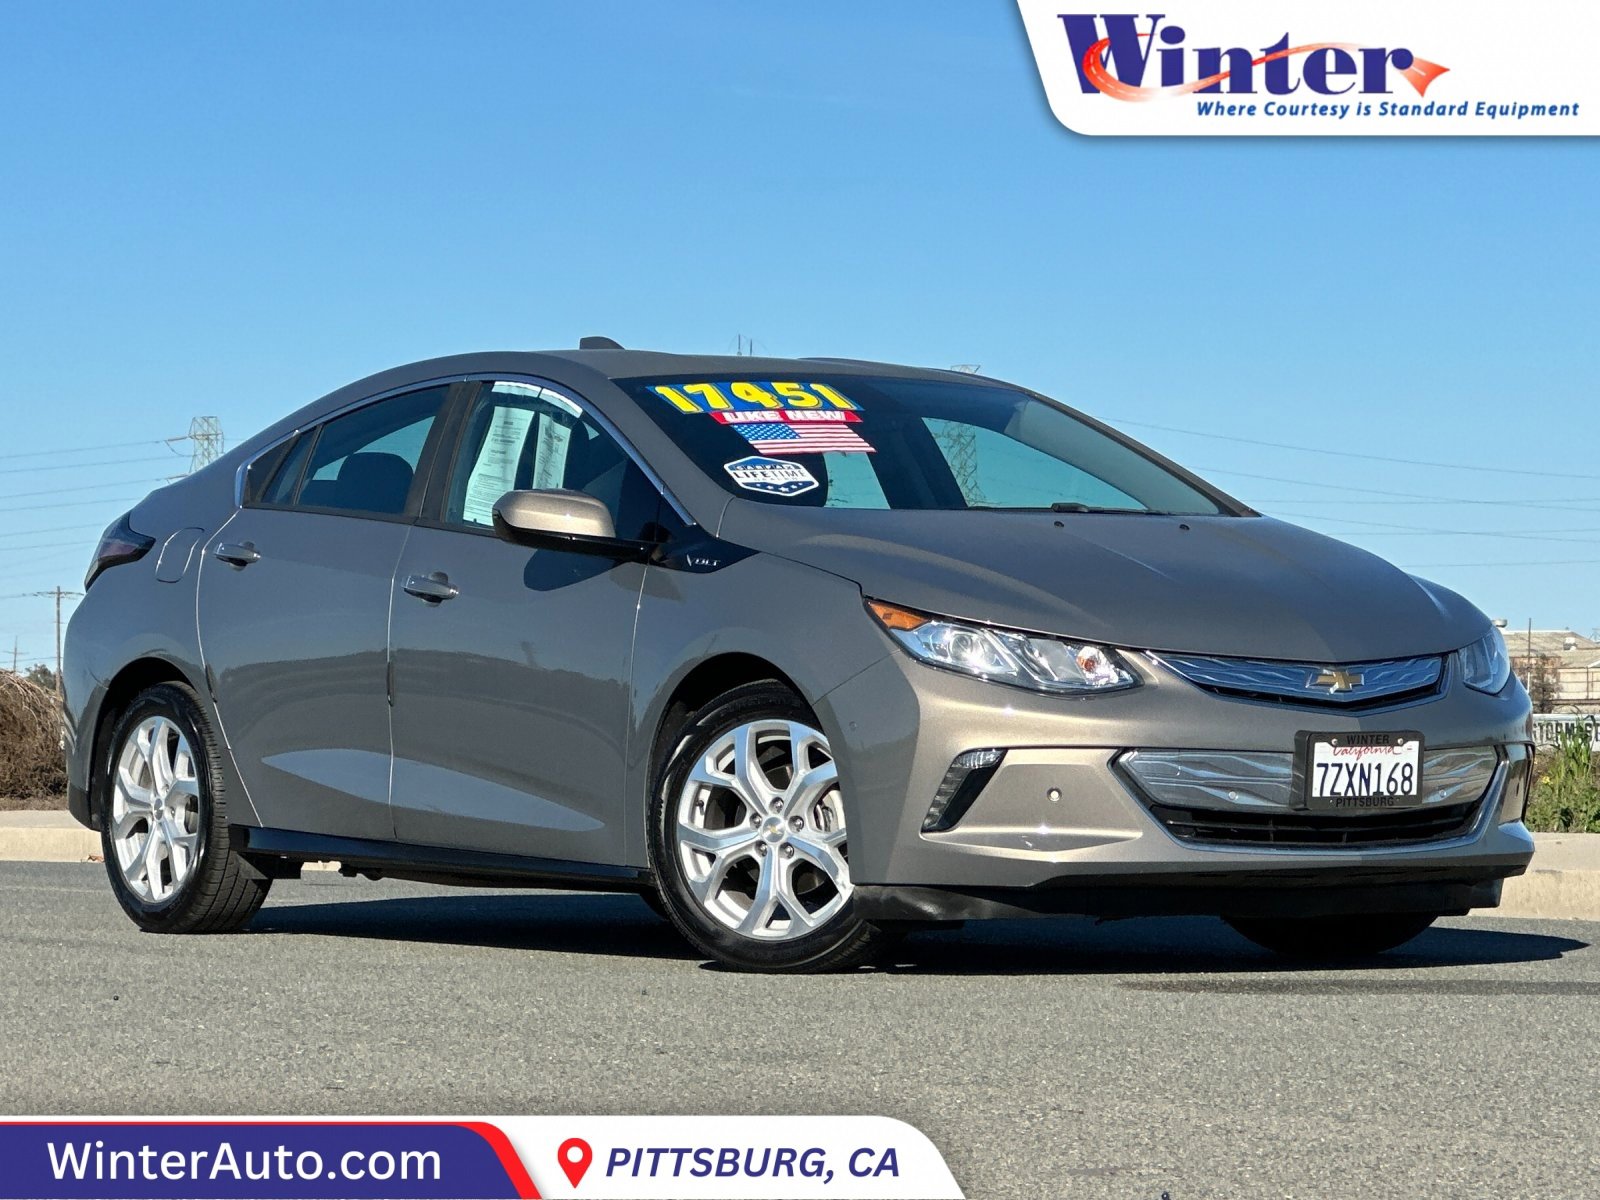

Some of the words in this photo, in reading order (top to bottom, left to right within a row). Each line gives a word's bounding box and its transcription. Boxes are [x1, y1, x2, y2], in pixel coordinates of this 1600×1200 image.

[654, 381, 857, 412] 17451
[721, 410, 783, 422] LIKE
[785, 409, 846, 421] NEW
[732, 470, 807, 479] LIFETIME
[1346, 735, 1390, 745] WINTER
[1316, 762, 1413, 797] 7ZXN168
[1336, 797, 1394, 807] PITTSBURG
